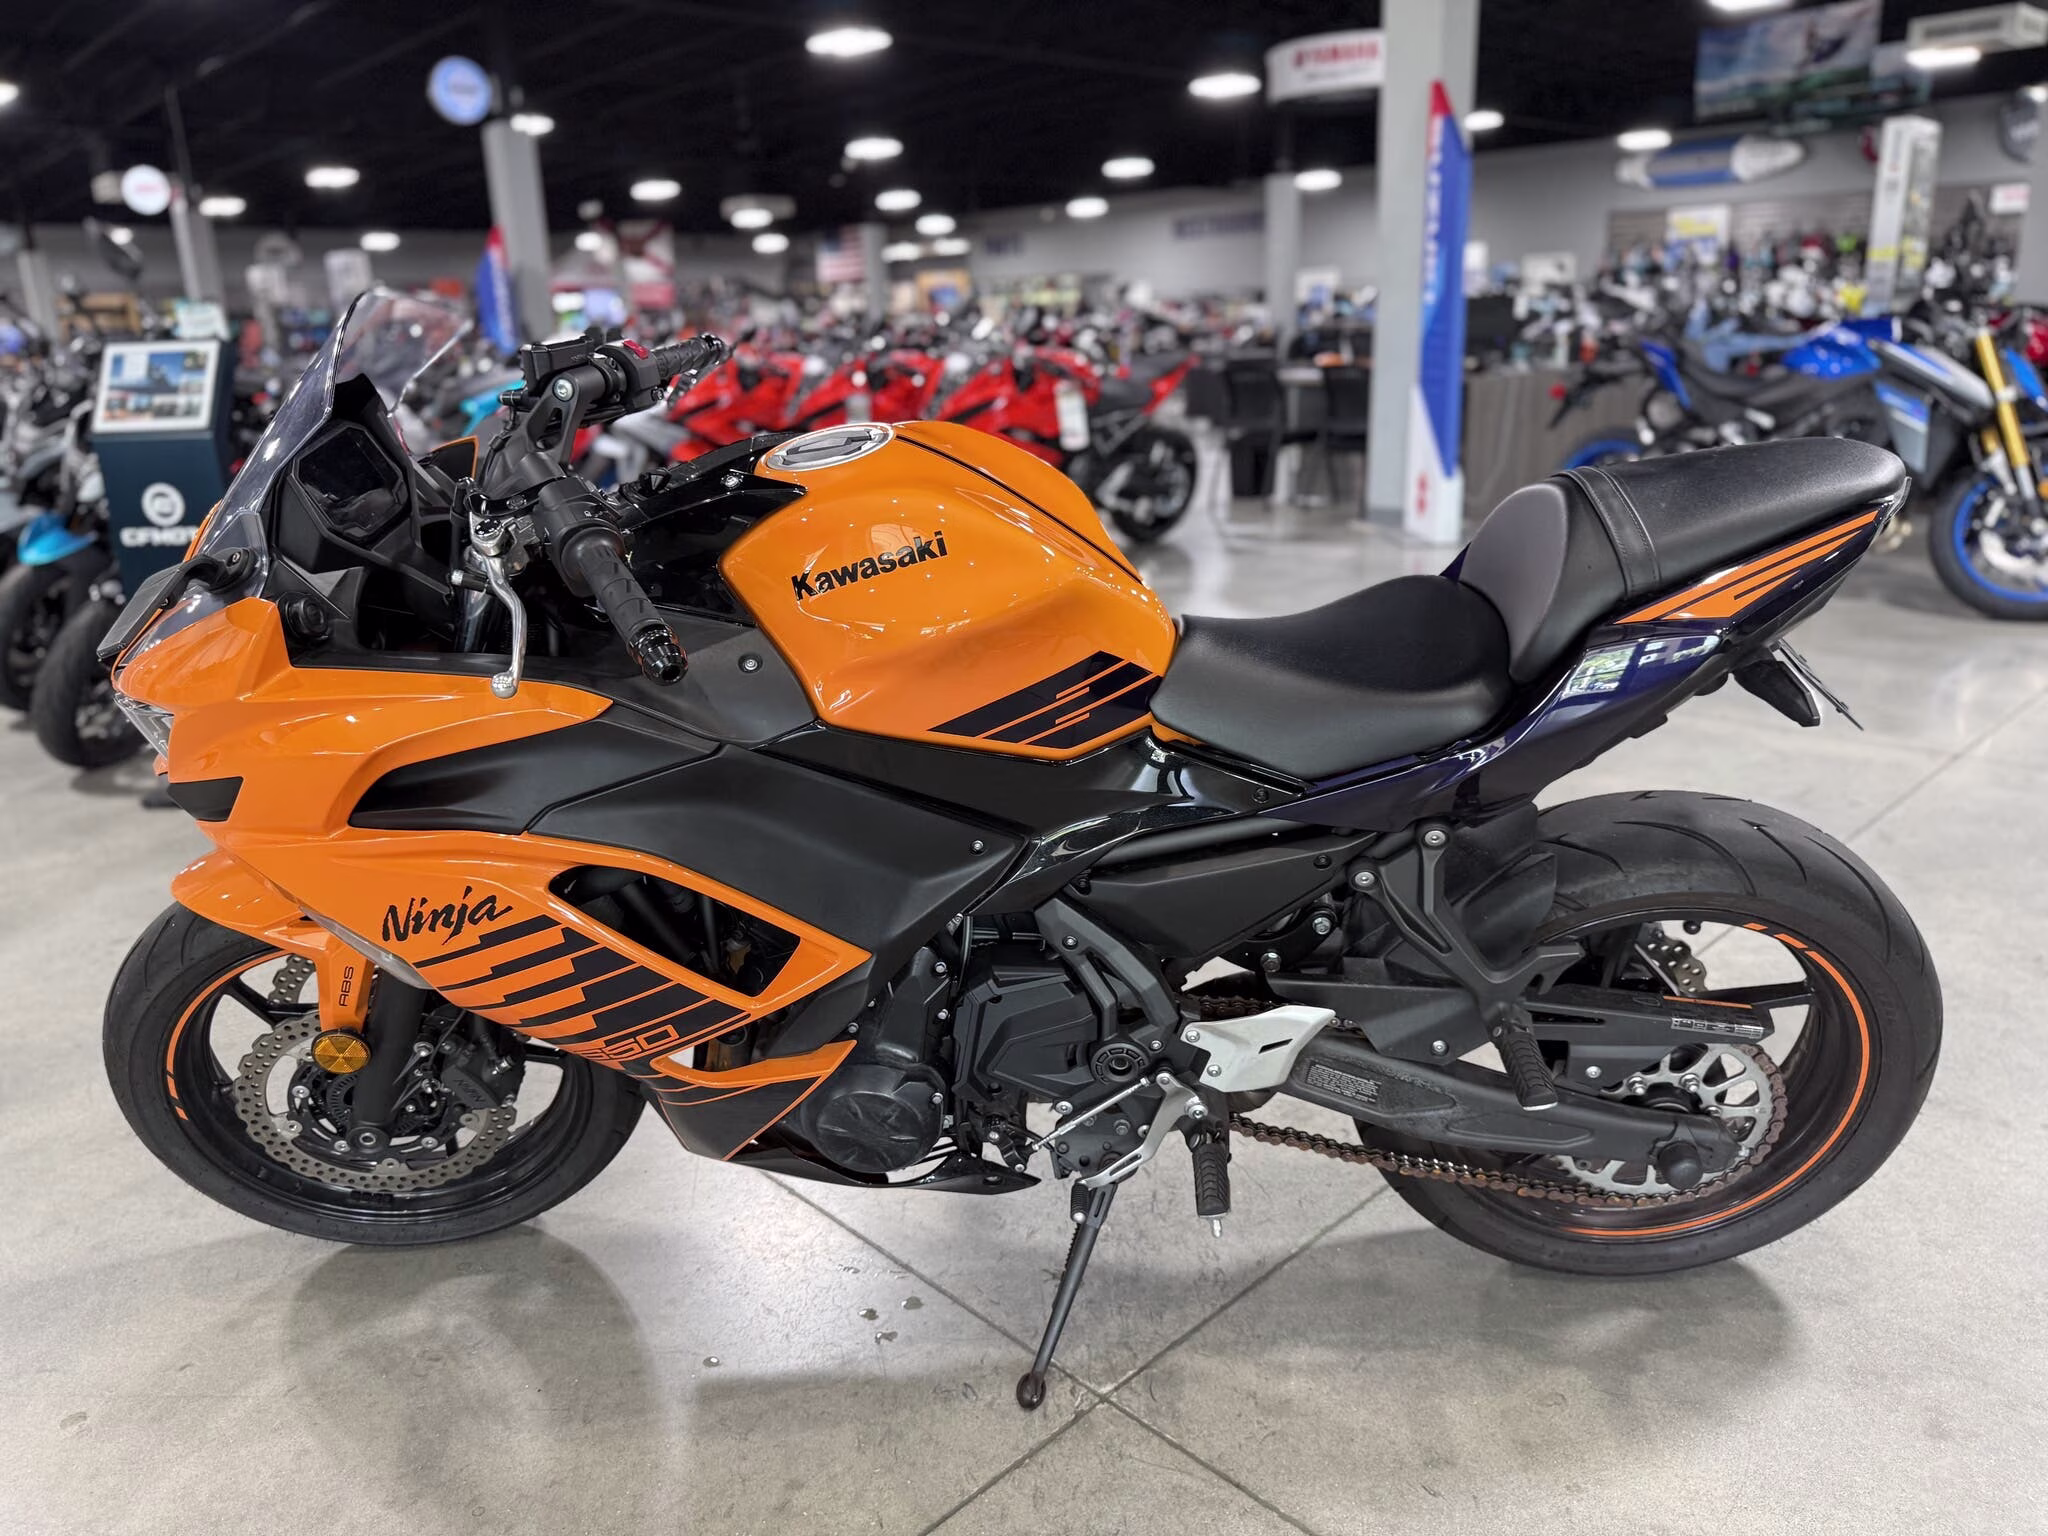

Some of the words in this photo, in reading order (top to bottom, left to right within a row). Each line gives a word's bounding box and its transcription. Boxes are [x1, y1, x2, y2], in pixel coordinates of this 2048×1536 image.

[791, 530, 948, 601] Kawasaki
[382, 885, 513, 946] Ninja
[338, 965, 354, 1007] ABS
